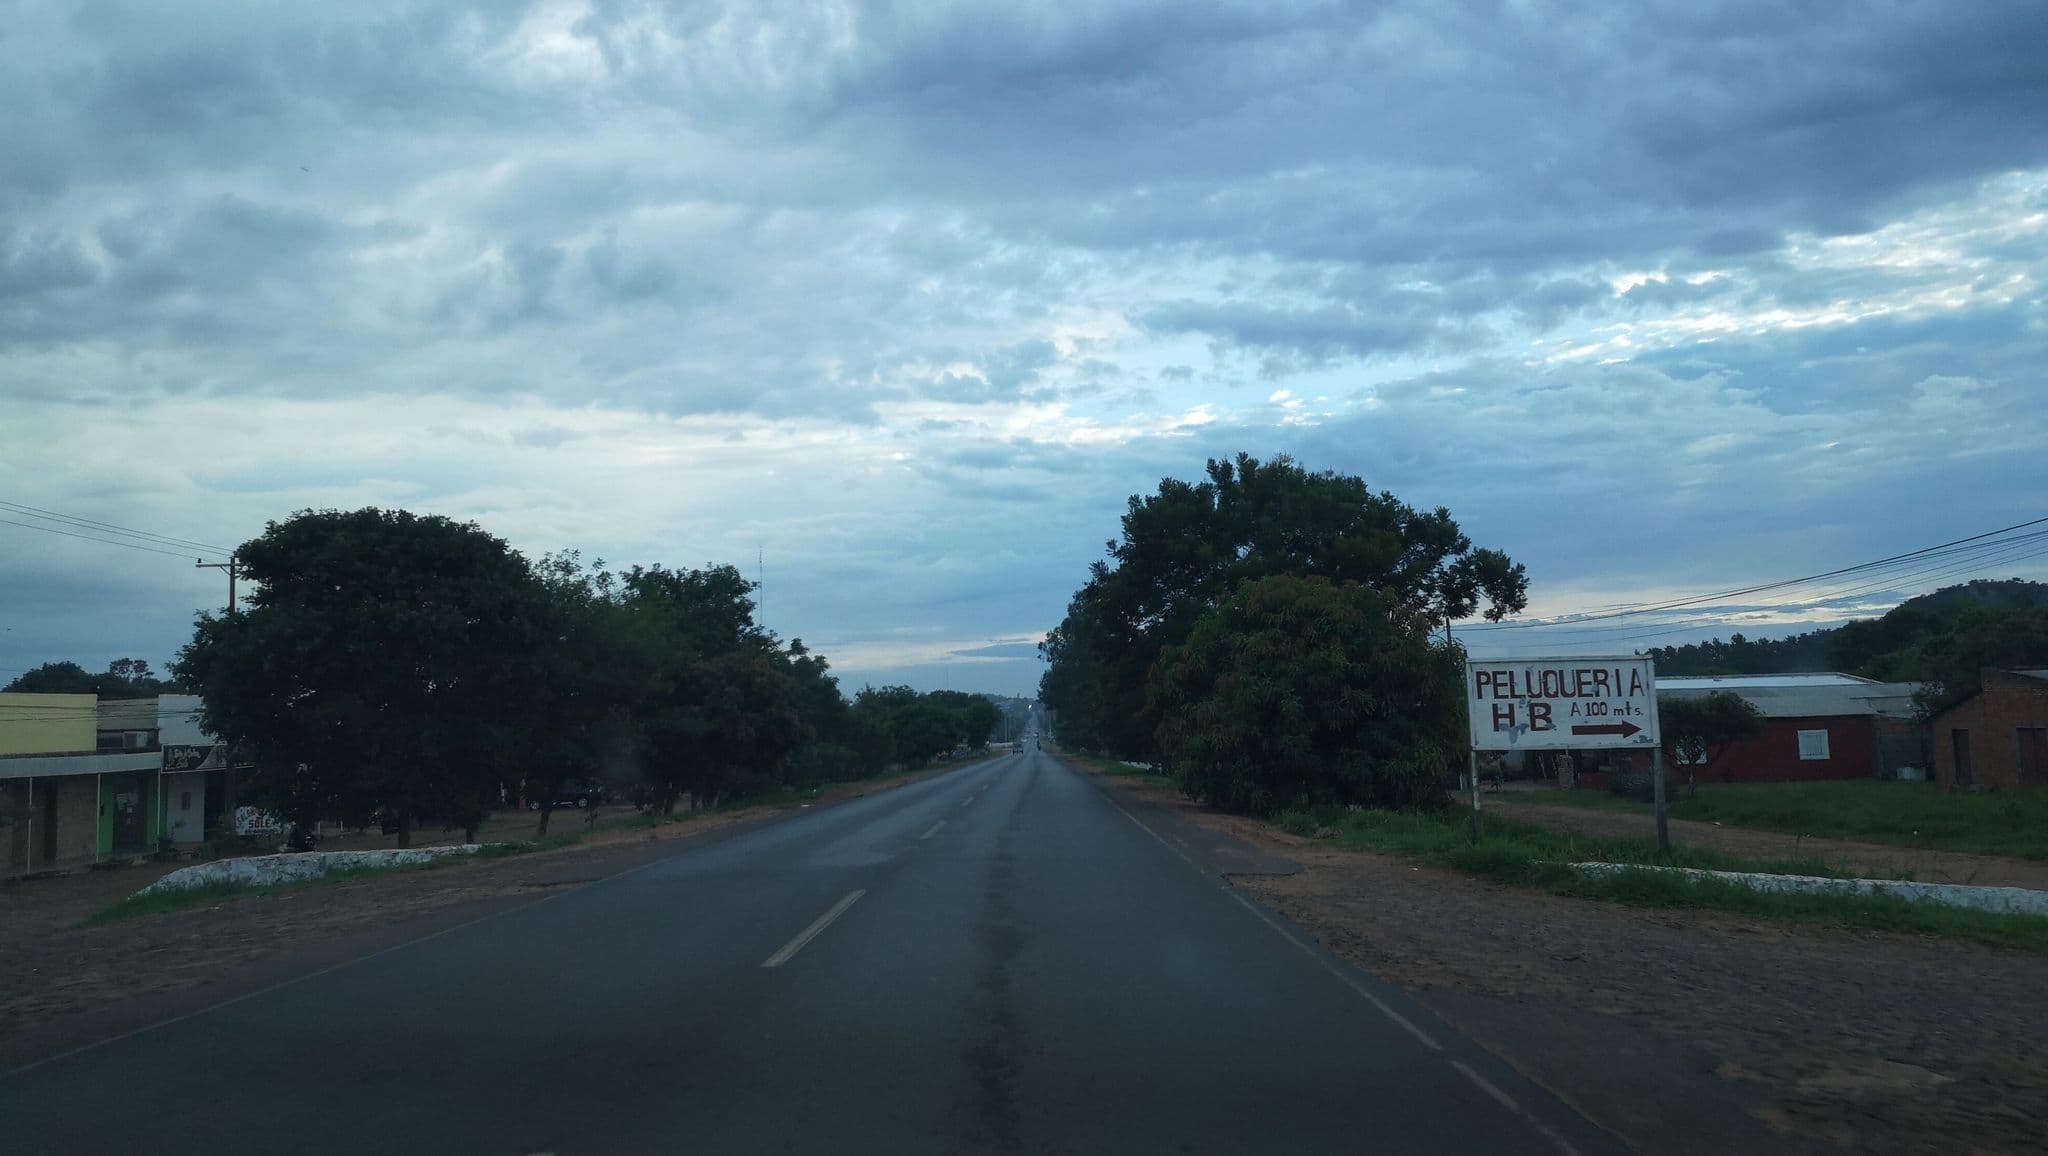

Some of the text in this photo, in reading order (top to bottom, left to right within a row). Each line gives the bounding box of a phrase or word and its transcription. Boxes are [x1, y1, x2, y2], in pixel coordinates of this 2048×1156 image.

[1475, 668, 1645, 699] PELUQUERIA
[1570, 704, 1581, 716] A
[1586, 702, 1608, 716] 100
